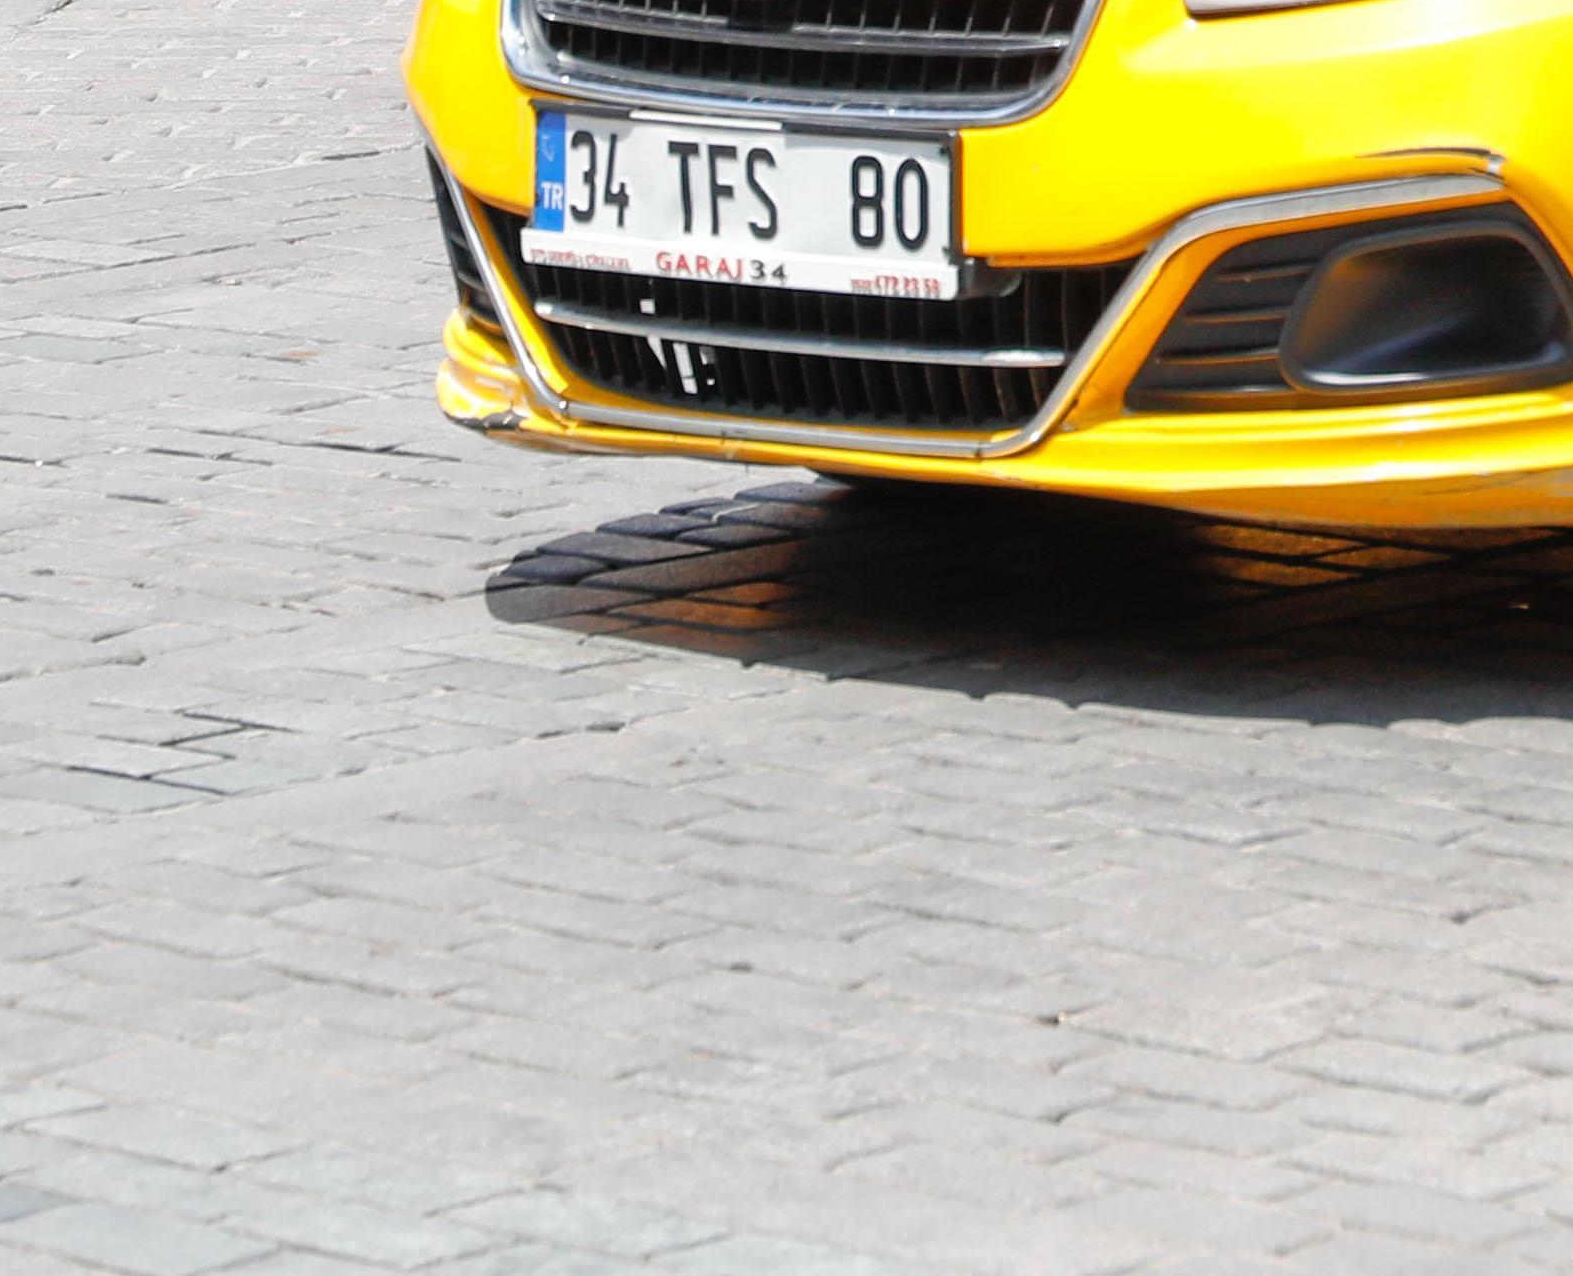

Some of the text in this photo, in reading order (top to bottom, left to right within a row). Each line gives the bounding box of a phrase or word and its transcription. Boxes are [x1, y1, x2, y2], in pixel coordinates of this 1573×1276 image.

[540, 181, 564, 211] TR
[569, 129, 929, 251] 34 TFS 80
